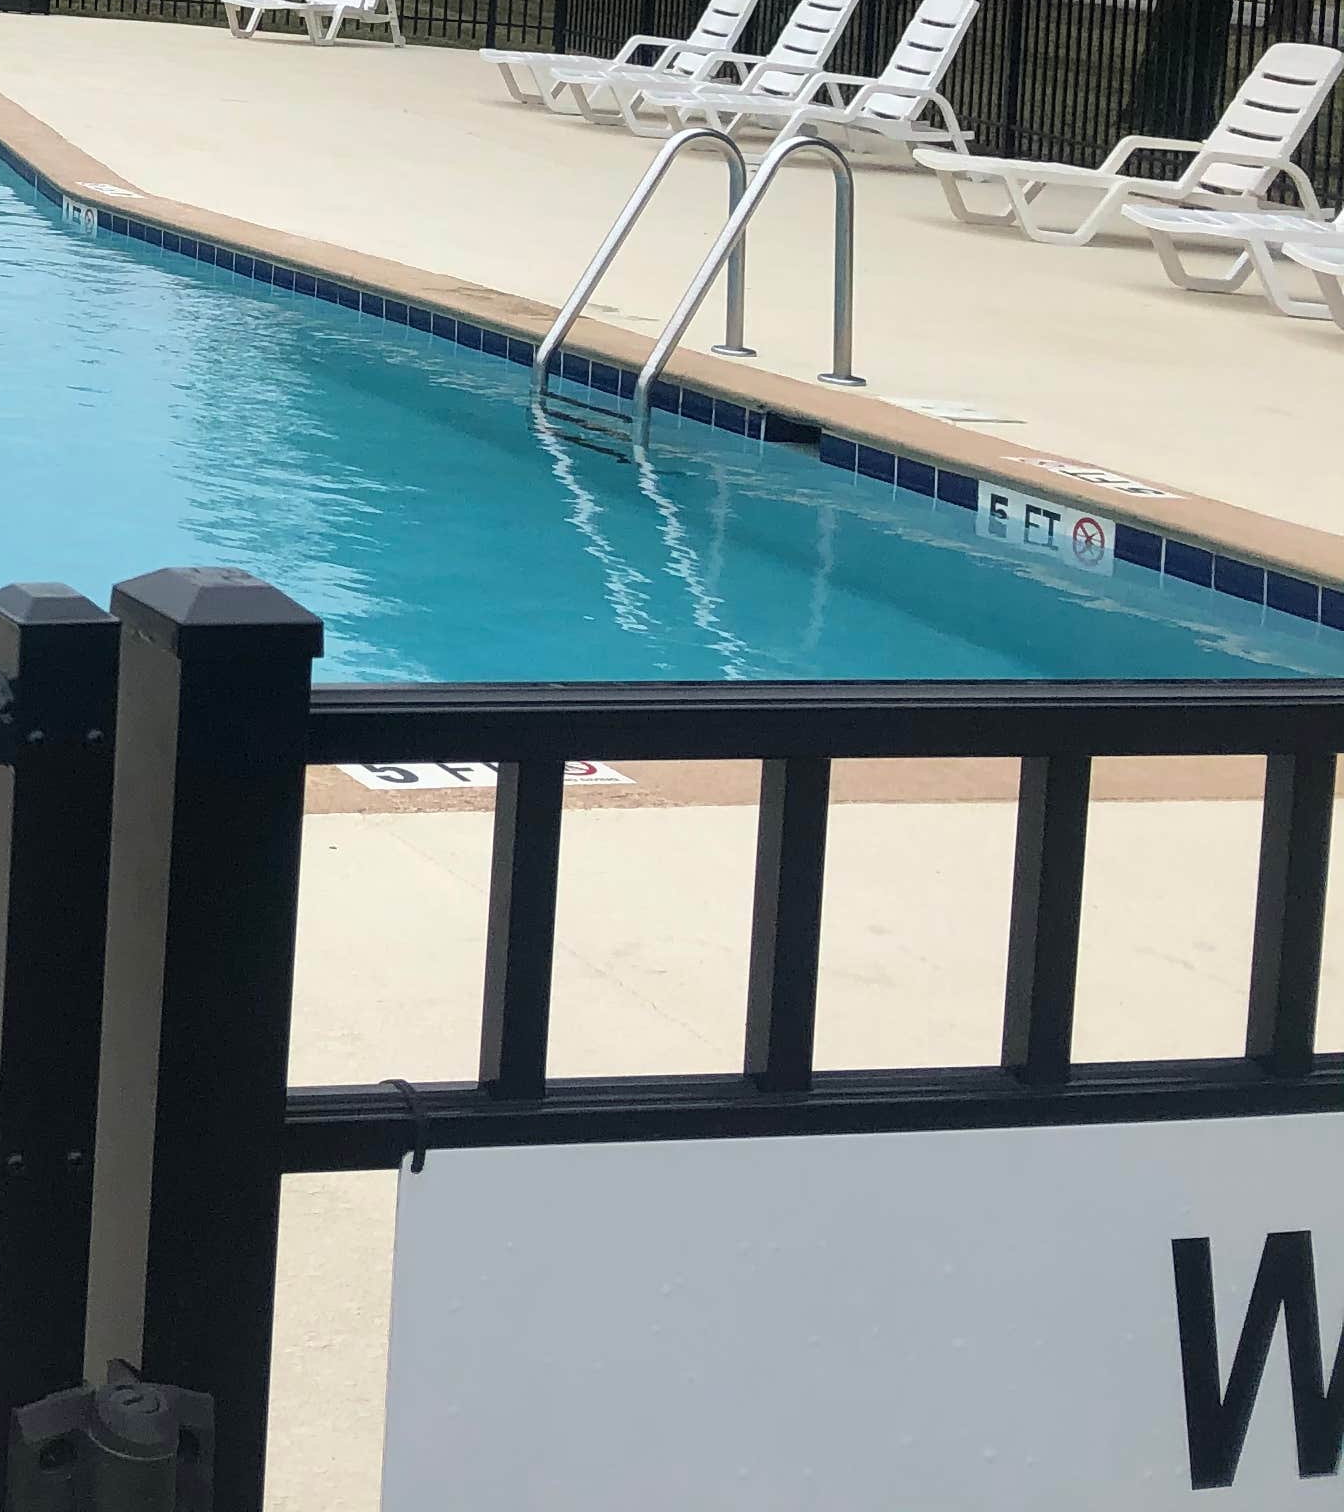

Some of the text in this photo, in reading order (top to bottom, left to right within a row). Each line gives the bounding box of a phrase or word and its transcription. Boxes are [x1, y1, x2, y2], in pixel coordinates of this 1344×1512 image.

[990, 493, 1061, 538] 5 FT
[361, 763, 419, 783] 5
